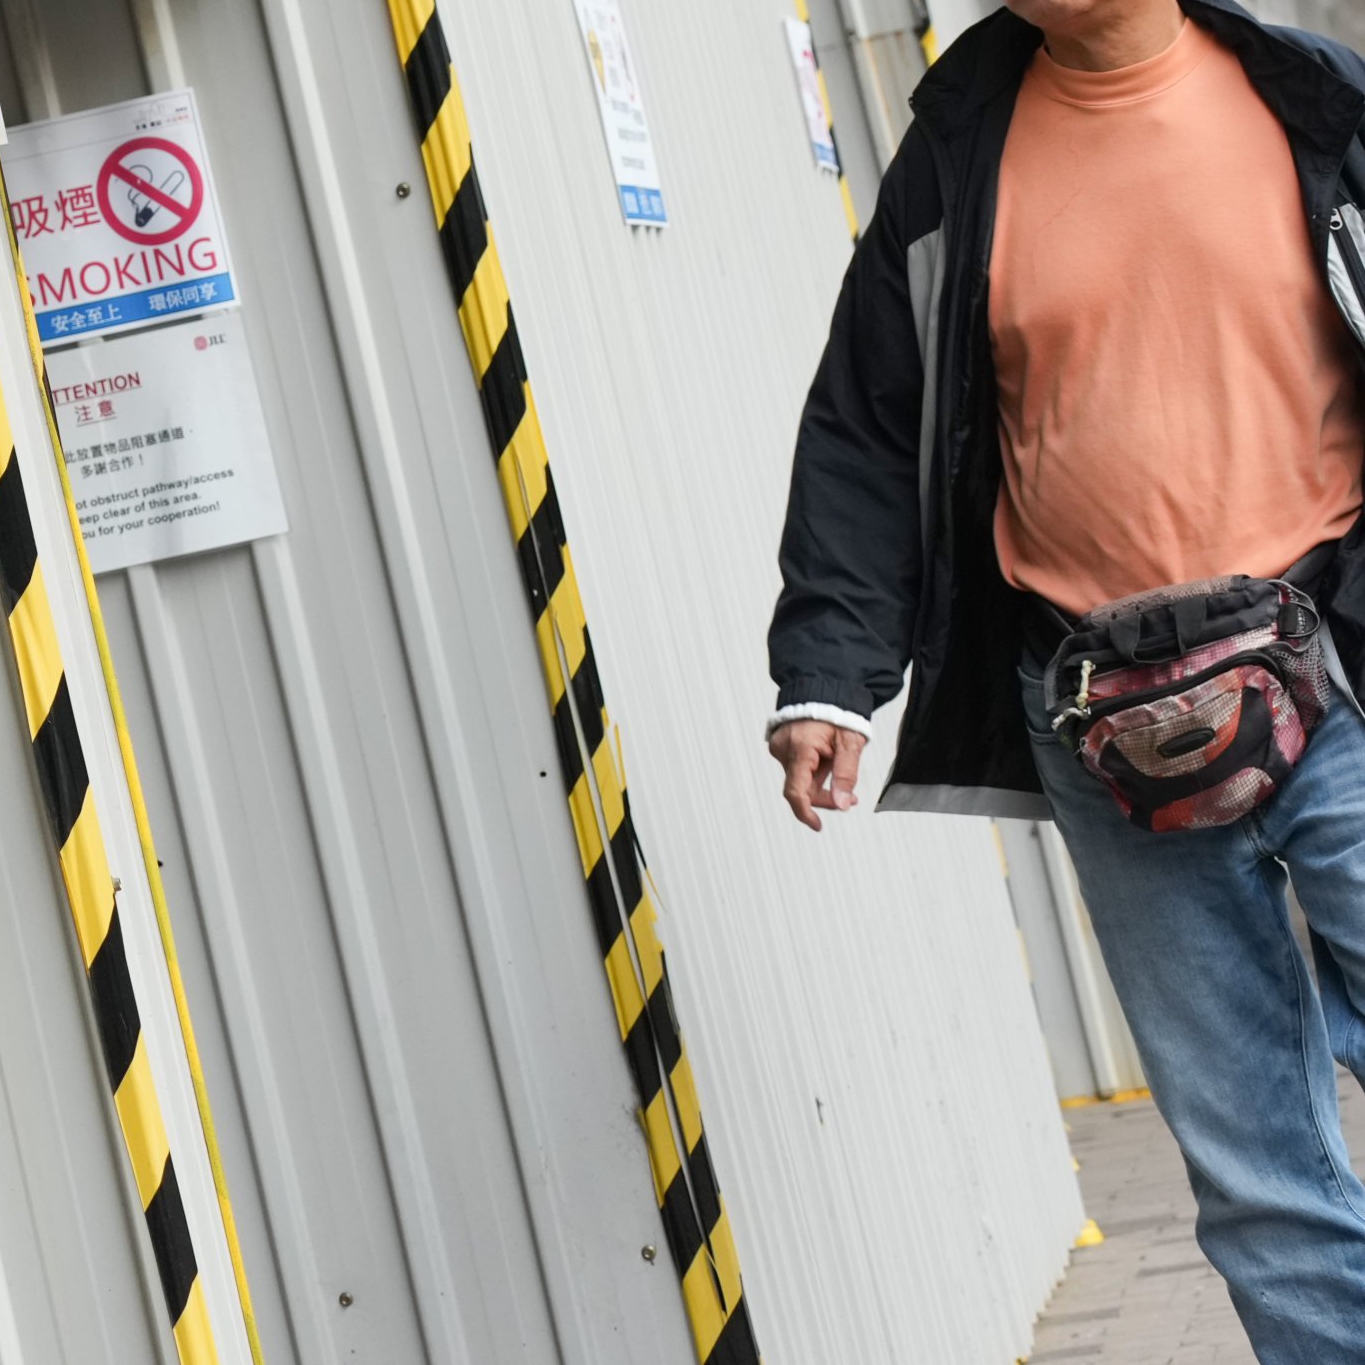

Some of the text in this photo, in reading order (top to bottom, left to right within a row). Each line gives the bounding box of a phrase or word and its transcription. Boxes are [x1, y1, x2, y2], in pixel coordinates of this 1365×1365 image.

[26, 236, 219, 308] MOKING
[51, 278, 220, 334] 安全至上 環保同享
[89, 488, 140, 508] obstruct
[141, 469, 234, 499] pathway/access
[102, 506, 131, 520] clear
[133, 500, 146, 513] of
[148, 498, 171, 509] this
[172, 492, 201, 506] area.
[97, 525, 115, 537] for
[117, 518, 145, 535] your
[146, 501, 220, 527] cooperation!
